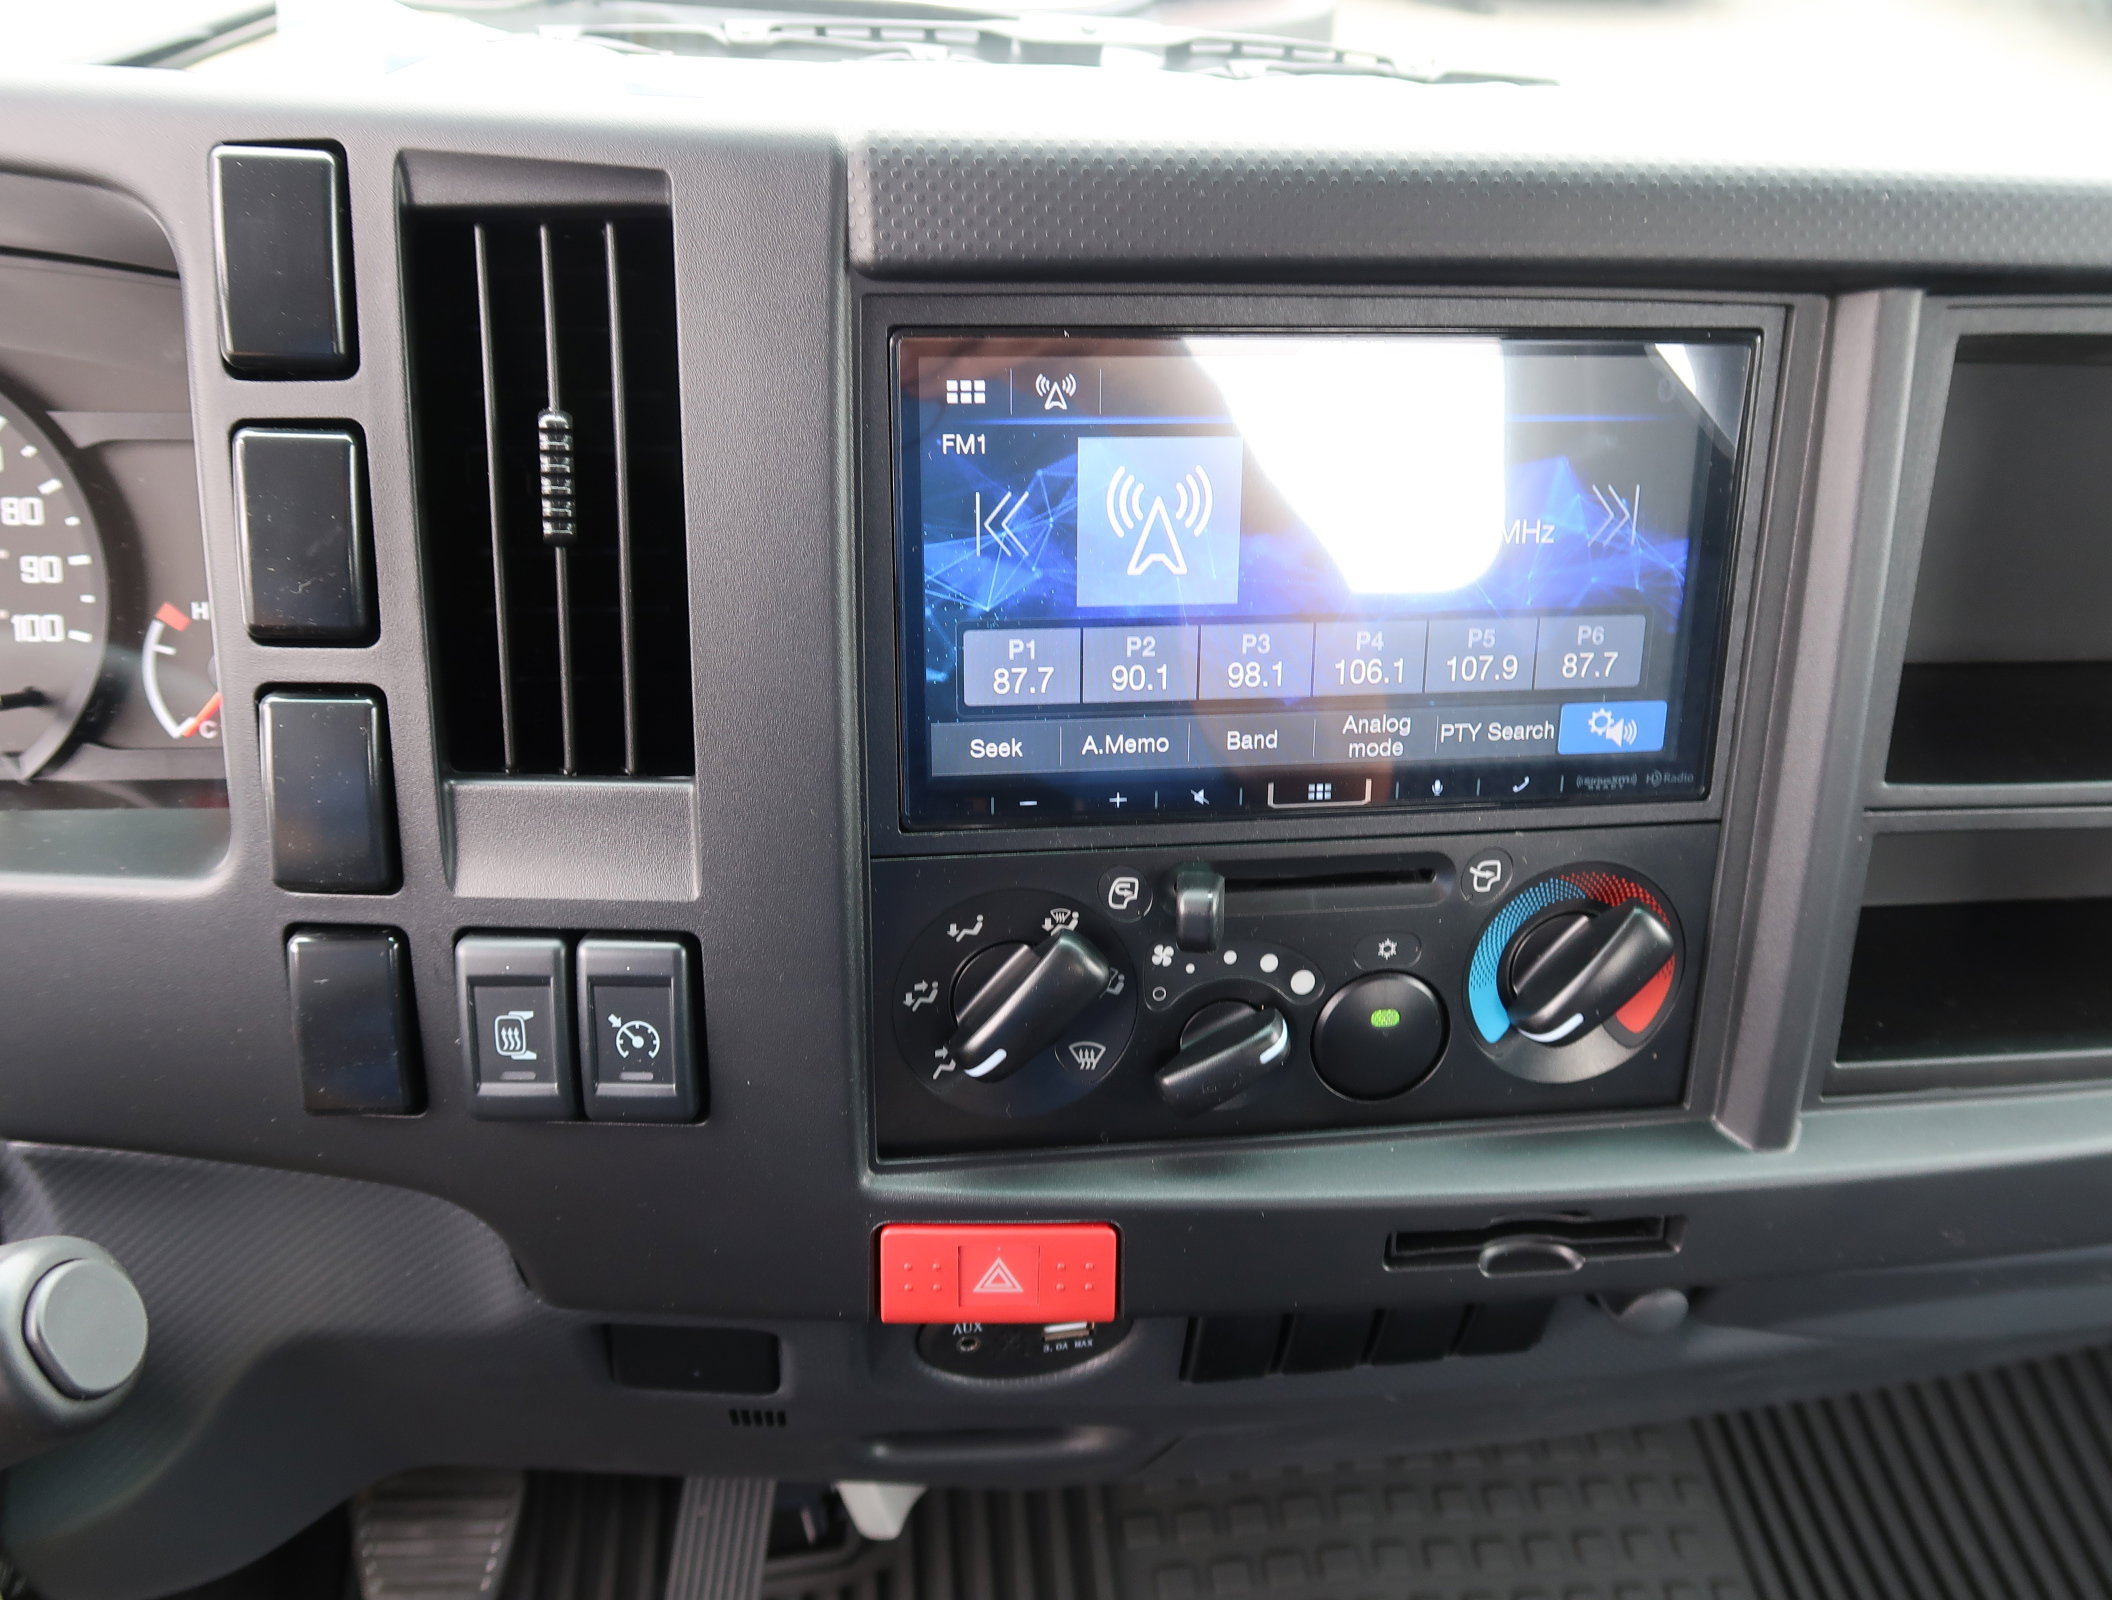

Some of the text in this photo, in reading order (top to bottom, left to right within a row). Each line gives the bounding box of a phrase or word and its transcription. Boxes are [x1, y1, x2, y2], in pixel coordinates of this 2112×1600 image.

[942, 433, 986, 454] FM1
[0, 497, 44, 525] 80
[1502, 519, 1555, 545] MHz
[19, 555, 63, 583] 90
[191, 602, 209, 620] H
[10, 613, 64, 642] 100
[1467, 628, 1496, 648] P5
[1577, 625, 1604, 646] P6
[1008, 639, 1036, 660] P1
[1126, 636, 1156, 657] P2
[1241, 633, 1271, 654] P3
[1356, 631, 1384, 651] P4
[1227, 661, 1284, 689] 98.1
[1334, 658, 1405, 686] 106.1
[1446, 655, 1519, 682] 107.9
[1561, 652, 1619, 679] 87.7
[992, 667, 1055, 695] 87.7
[1111, 664, 1168, 692] 90.1
[199, 721, 217, 738] C
[1342, 715, 1411, 737] Analog
[1440, 721, 1555, 743] PTY Search
[969, 738, 1023, 759] Seek
[1081, 735, 1170, 756] A.Memo
[1226, 730, 1278, 751] Band
[1348, 738, 1404, 758] mode
